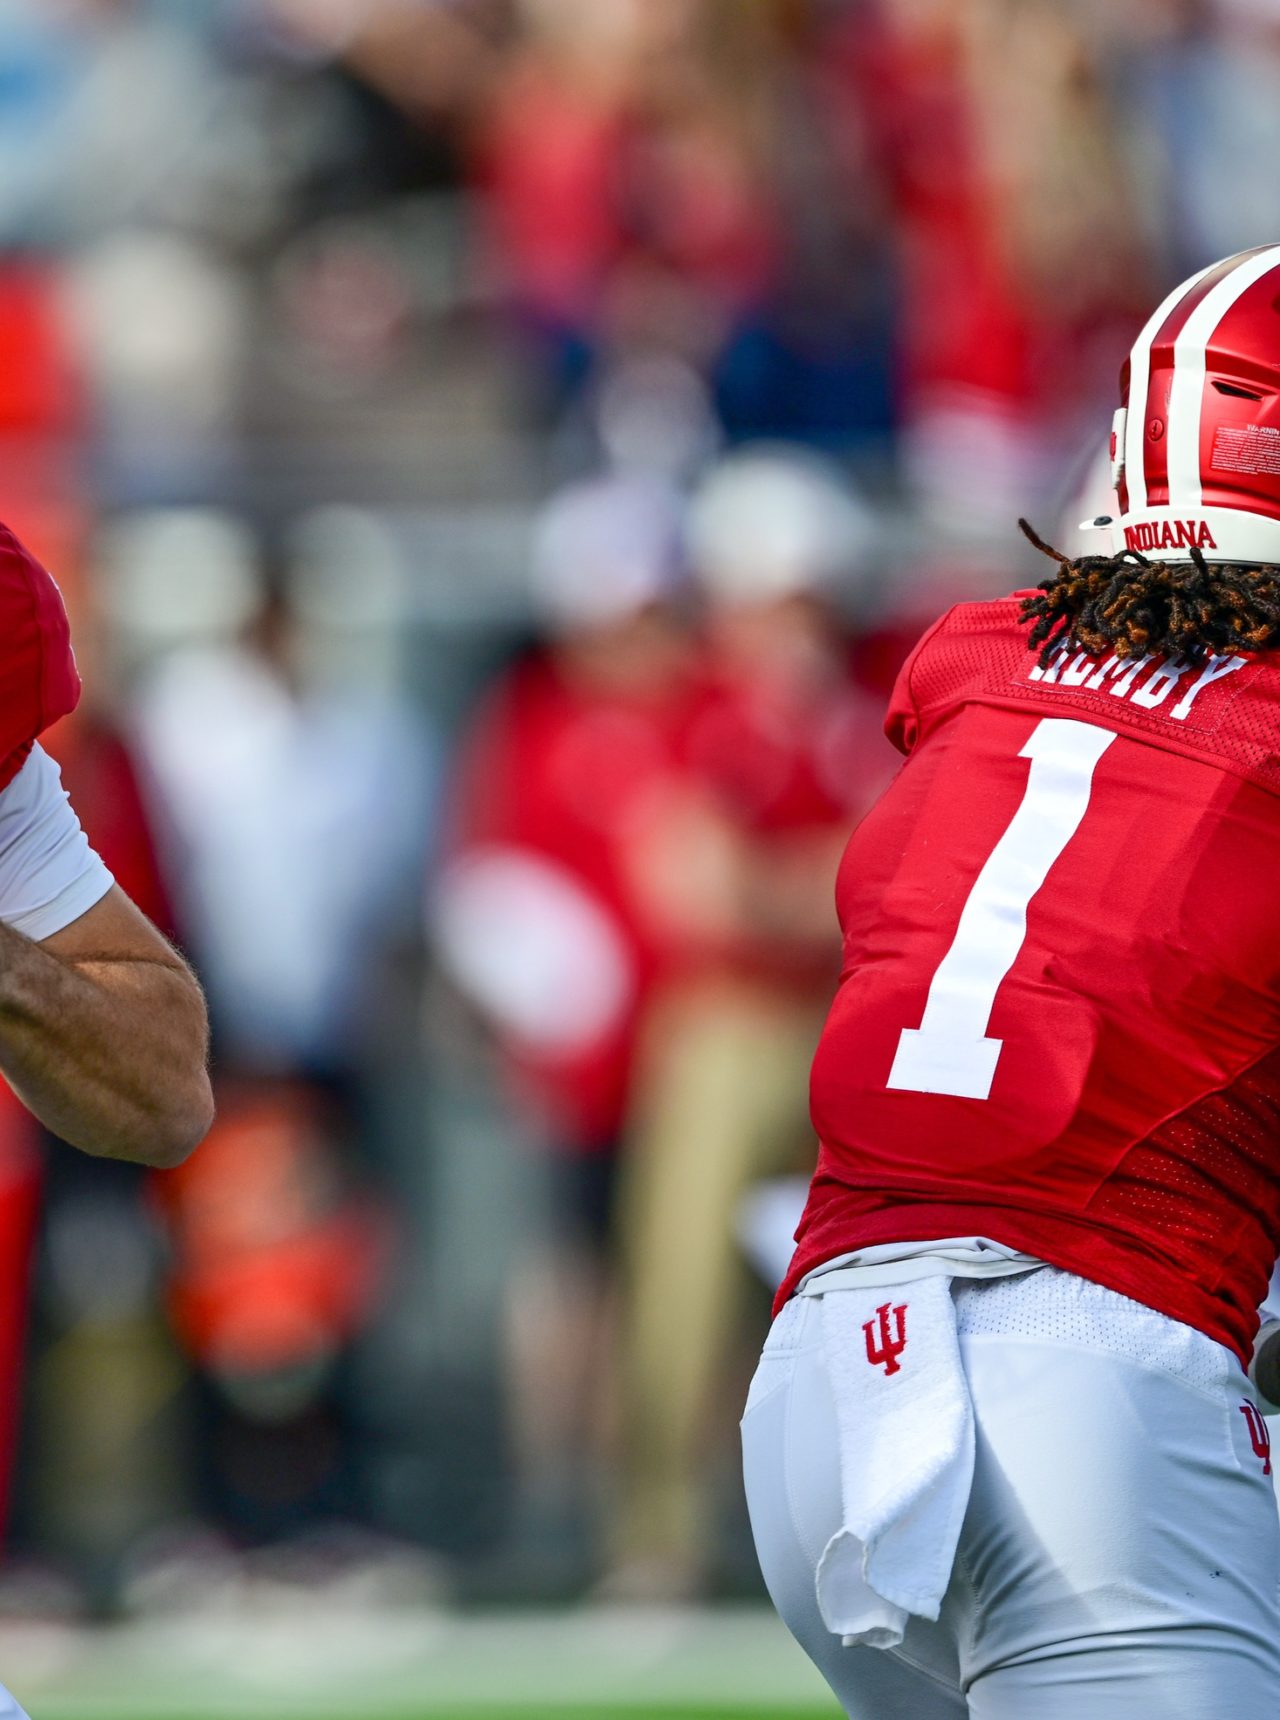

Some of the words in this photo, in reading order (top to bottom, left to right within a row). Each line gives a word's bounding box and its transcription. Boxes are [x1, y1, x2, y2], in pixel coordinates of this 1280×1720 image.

[1246, 423, 1280, 436] WARNIN
[1123, 520, 1217, 552] INDIANA
[886, 718, 1119, 1100] 1
